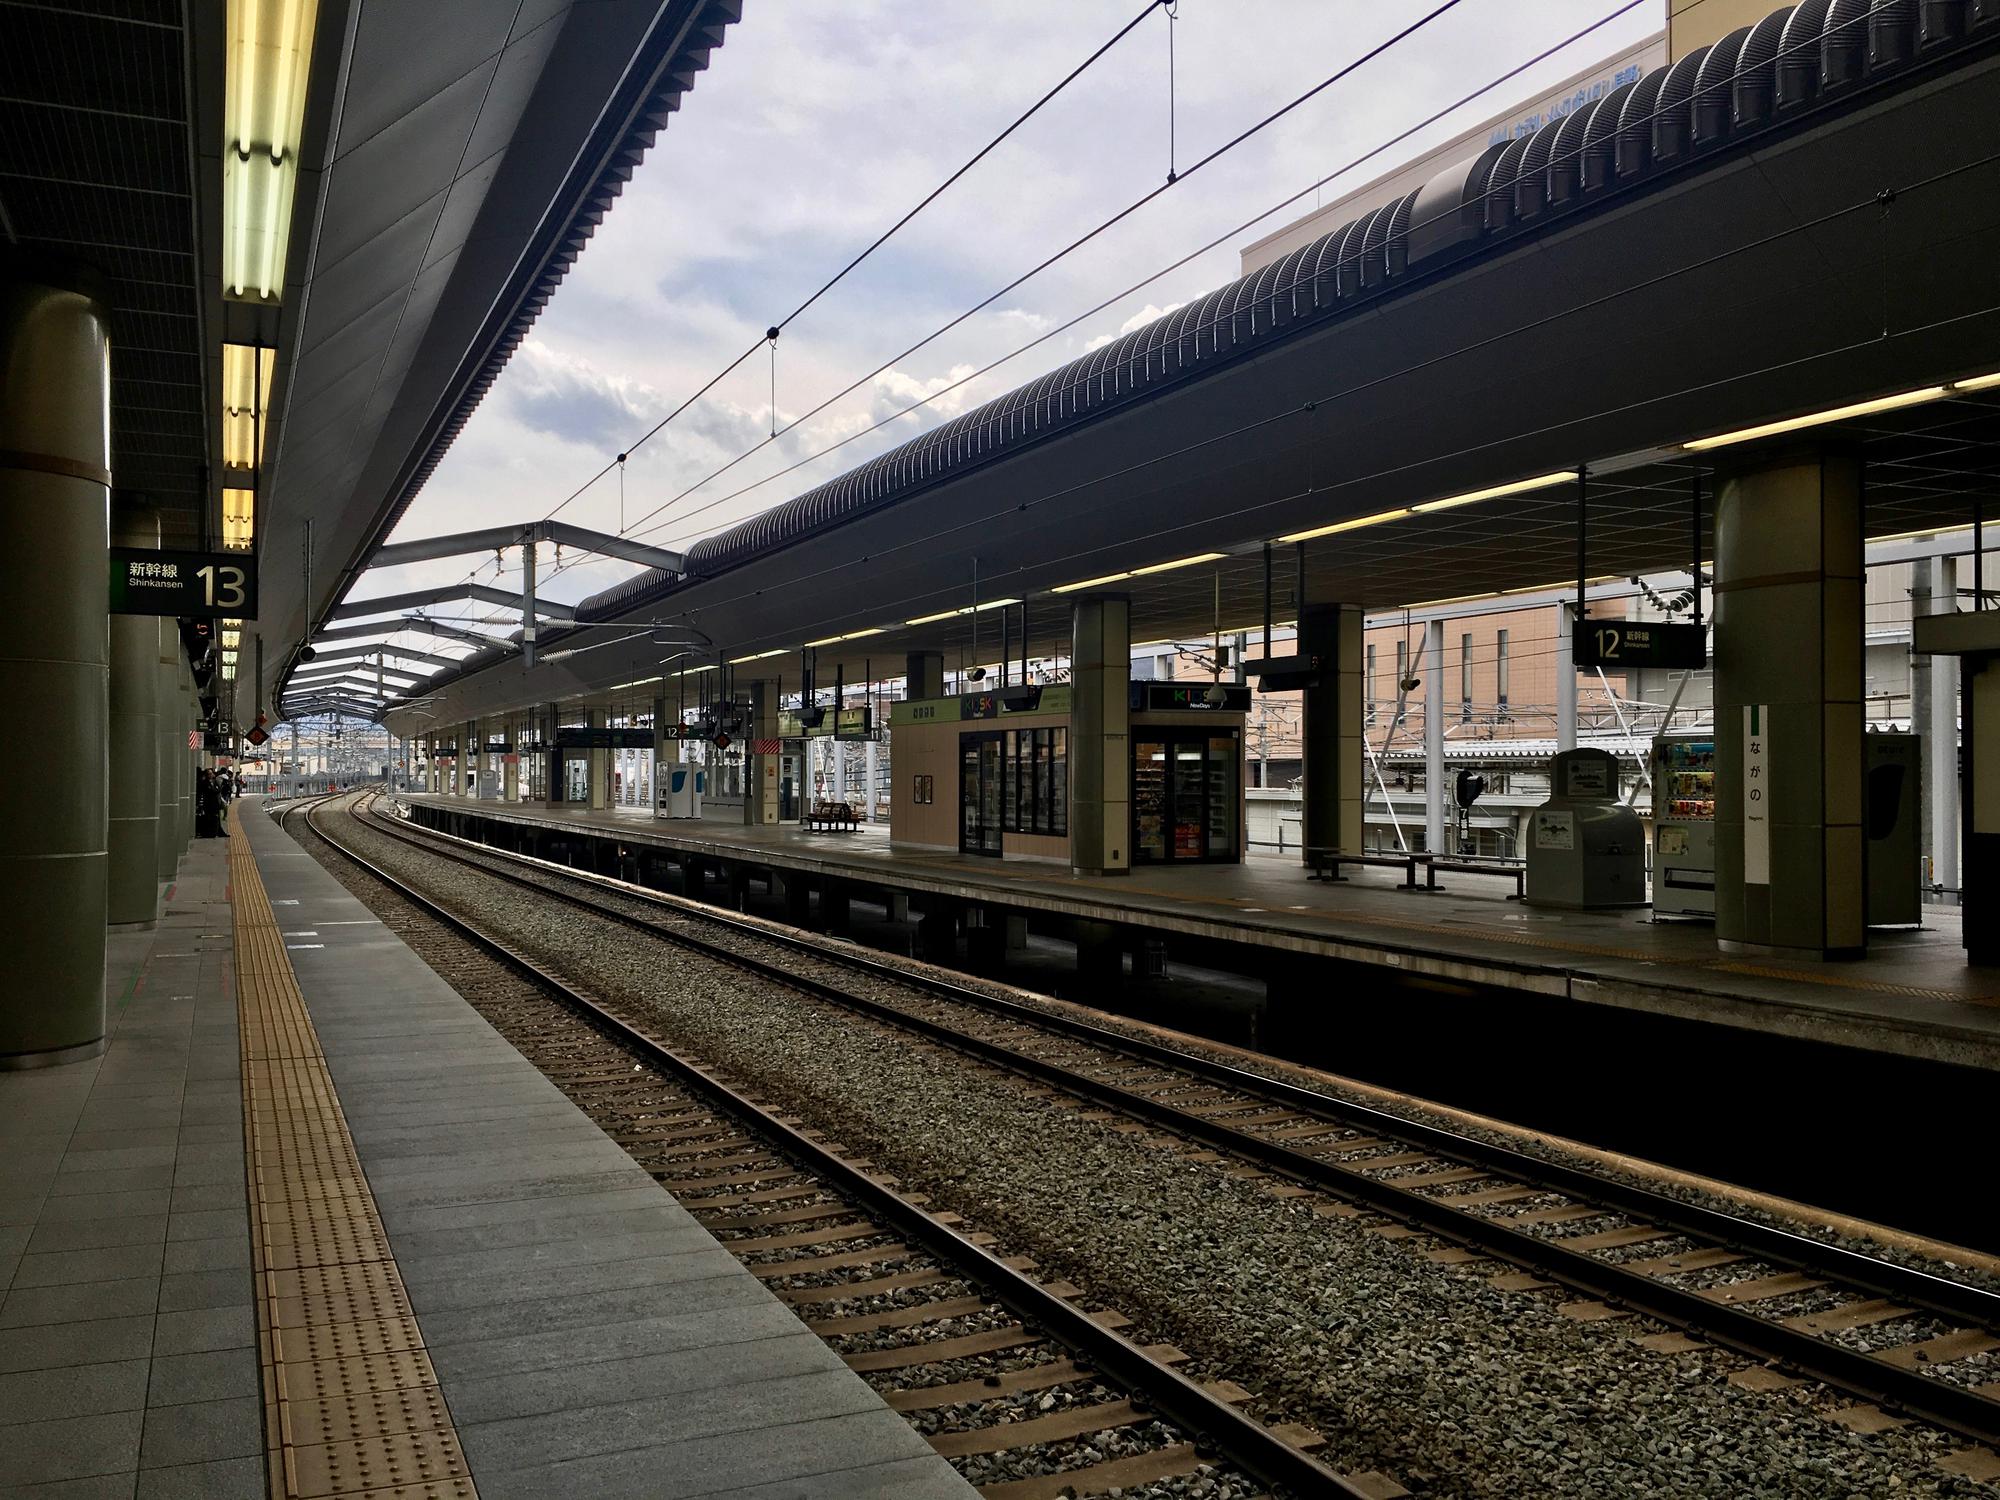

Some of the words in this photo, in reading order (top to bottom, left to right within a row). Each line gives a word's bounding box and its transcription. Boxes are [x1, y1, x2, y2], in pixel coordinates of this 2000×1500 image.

[129, 562, 178, 578] 新幹線
[129, 577, 183, 589] Shinkansen
[196, 565, 246, 608] 13
[1595, 629, 1620, 658] 12
[1626, 630, 1650, 642] 新幹線
[965, 695, 993, 713] KIOSK
[217, 722, 229, 734] 13
[666, 727, 678, 738] 12
[1750, 741, 1762, 801] ながの
